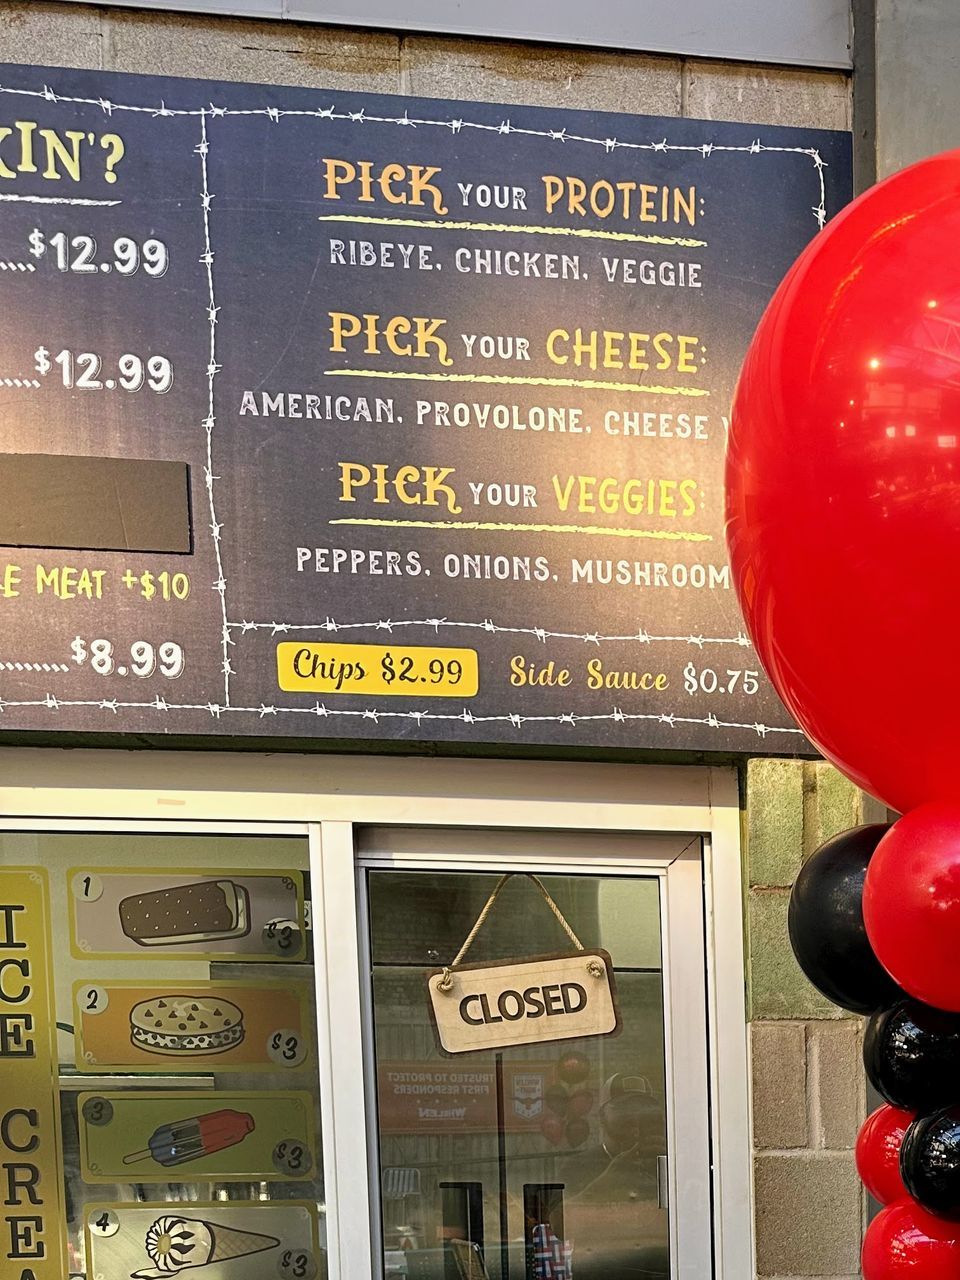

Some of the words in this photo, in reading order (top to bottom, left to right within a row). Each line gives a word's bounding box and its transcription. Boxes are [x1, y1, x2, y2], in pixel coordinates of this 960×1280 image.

[322, 158, 449, 215] PICK
[457, 182, 527, 211] YOUR
[542, 176, 705, 226] PROTEIN:
[29, 229, 169, 278] $12.99
[602, 257, 702, 288] VEGGIE
[328, 312, 453, 366] PICK
[461, 334, 531, 361] YOUR
[546, 328, 708, 374] CHEESE:
[34, 346, 174, 393] $12.99
[604, 410, 709, 440] CHEESE
[337, 462, 462, 514] PICK
[468, 482, 538, 508] YOUR
[552, 474, 705, 518] VEGGIES:
[36, 564, 107, 600] MEAT
[122, 563, 191, 600] +$10
[70, 636, 186, 680] $8.99
[293, 648, 369, 690] Chips
[381, 652, 463, 685] $2.99
[509, 656, 572, 689] Side
[587, 659, 669, 692] Sauce
[683, 661, 760, 696] $0.75
[83, 876, 91, 897] 1
[87, 989, 98, 1010] 2
[458, 982, 588, 1026] CLOSED
[95, 1212, 110, 1232] 4
